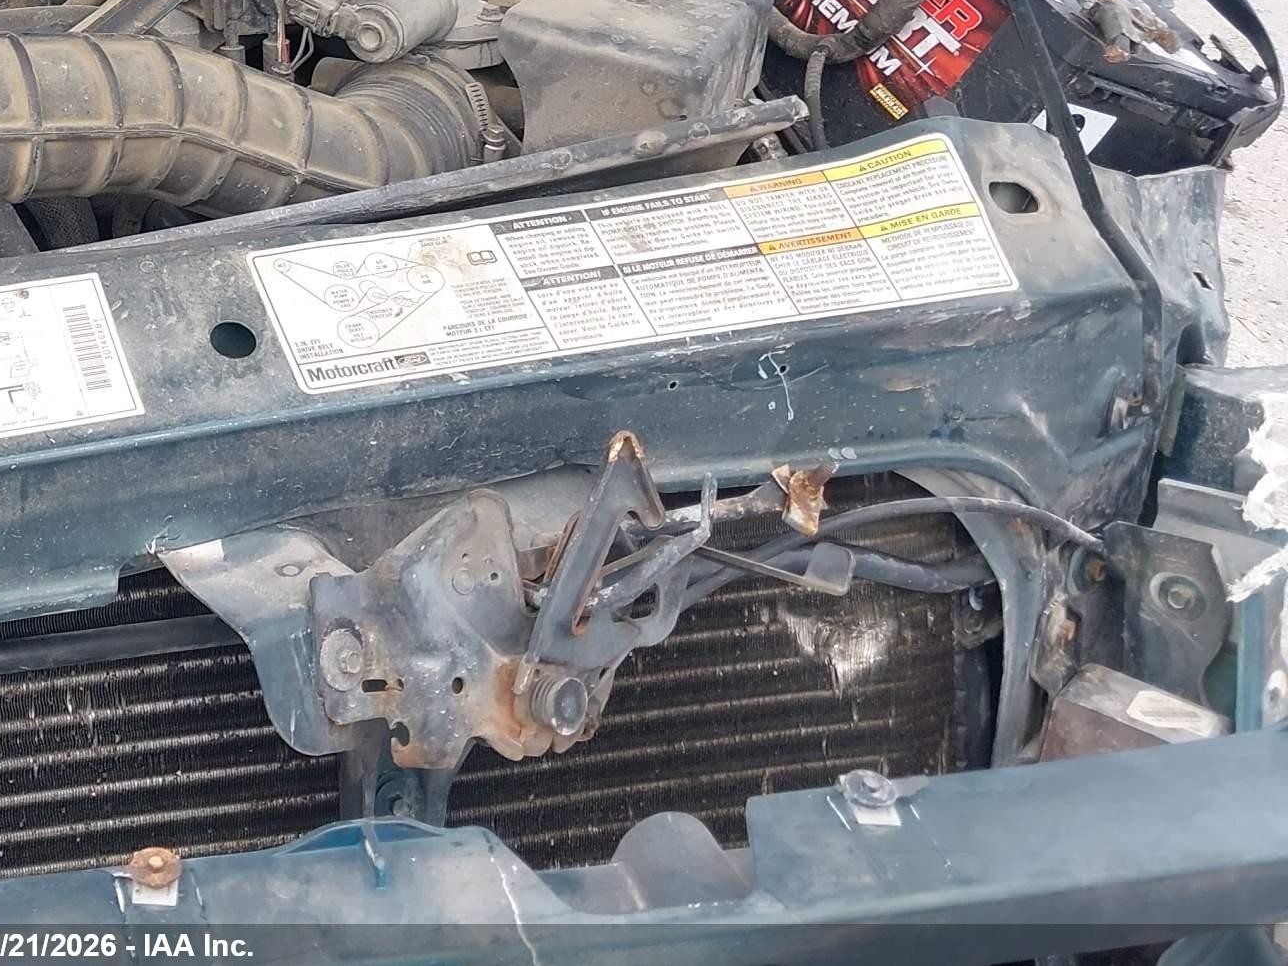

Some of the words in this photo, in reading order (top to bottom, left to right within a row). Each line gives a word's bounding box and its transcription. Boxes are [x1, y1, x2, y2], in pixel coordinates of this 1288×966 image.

[867, 150, 912, 168] CAUTION
[757, 177, 802, 190] WARNING
[611, 204, 644, 214] ENGINE
[645, 200, 669, 208] FAILS
[683, 193, 711, 202] START
[511, 214, 567, 229] ATTENTION
[888, 217, 914, 228] MISE
[915, 213, 929, 221] EN
[930, 207, 962, 218] GARDE
[777, 232, 853, 248] AVERTISSEMENT
[641, 260, 675, 270] MOTEUR
[675, 255, 705, 264] REFUSE
[305, 356, 398, 382] Motorcraft
